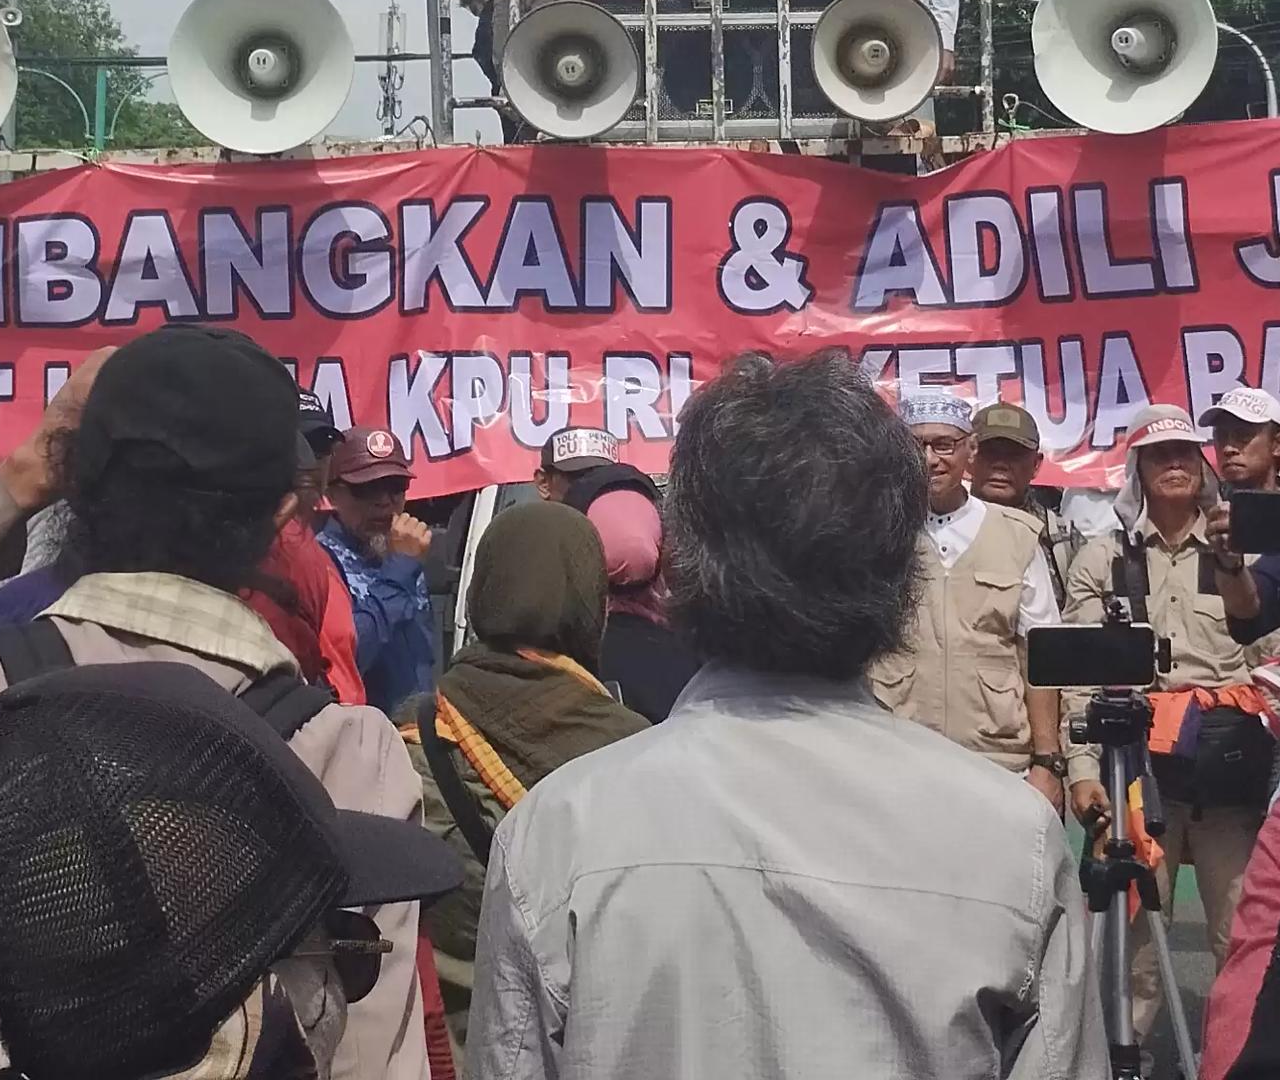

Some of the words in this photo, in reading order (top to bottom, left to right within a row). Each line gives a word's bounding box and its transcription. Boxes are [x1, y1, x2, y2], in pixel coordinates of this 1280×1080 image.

[718, 194, 812, 315] &
[852, 175, 1201, 314] ADILI
[387, 350, 573, 462] KPU
[602, 350, 693, 441] RI
